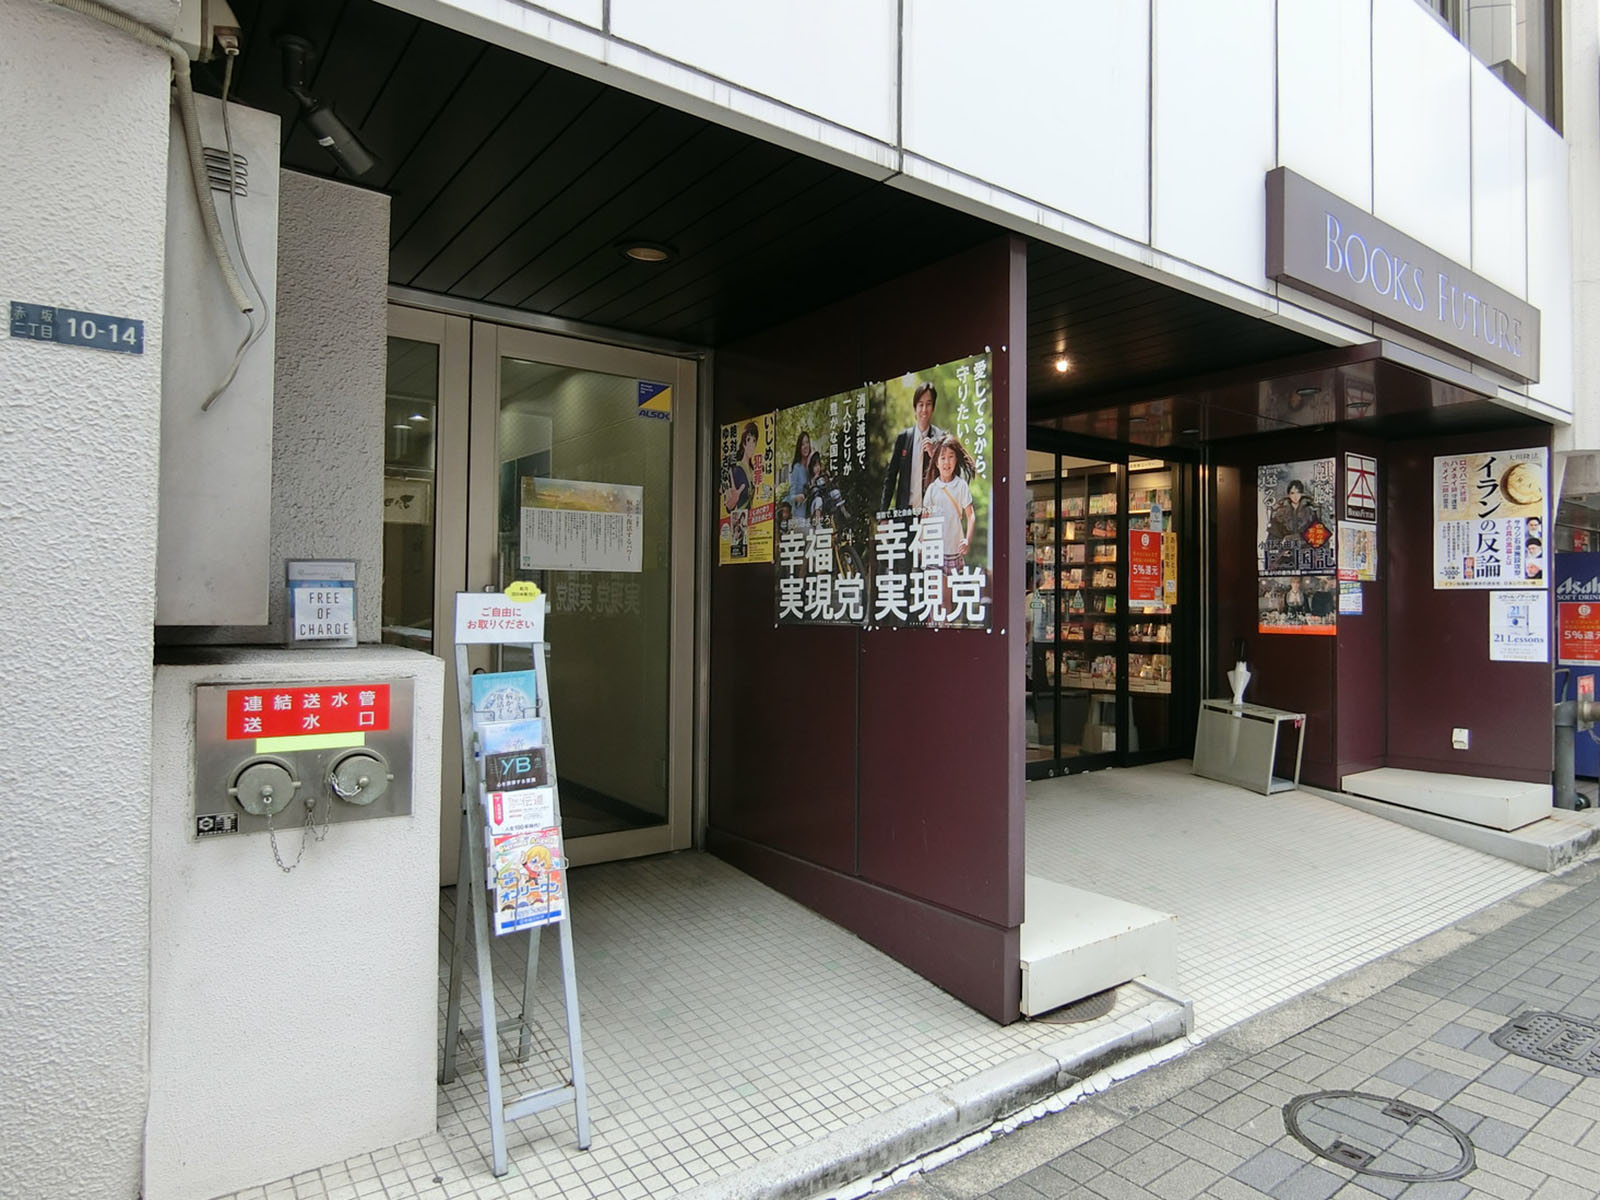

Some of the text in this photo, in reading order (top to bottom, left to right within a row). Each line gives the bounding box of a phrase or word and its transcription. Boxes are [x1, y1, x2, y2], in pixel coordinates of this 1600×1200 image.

[1325, 212, 1523, 358] BOOKS FUTURE
[14, 306, 53, 323] 赤坂
[14, 322, 53, 339] 二丁目
[67, 317, 137, 346] 10-14
[638, 409, 671, 421] ALSOK
[956, 365, 970, 446] 守りたい。
[973, 360, 987, 480] 愛してるから、
[764, 416, 774, 475] いじめは
[829, 402, 839, 478] 豊かな国に。
[843, 399, 852, 477] 一人ひとりが
[856, 392, 866, 470] 消費減税で、
[1476, 456, 1501, 579] イランの反論
[779, 527, 834, 574] 幸福
[875, 515, 946, 569] 幸福
[308, 592, 340, 605] FREE
[779, 570, 865, 621] 実現党
[874, 565, 987, 622] 実現党
[317, 608, 332, 620] OF
[466, 619, 535, 630] お取りください
[481, 606, 522, 617] ご自由に
[299, 622, 350, 636] CHARGE
[1494, 633, 1545, 644] 21 Lessons
[243, 690, 376, 713] 連結送水管
[243, 711, 376, 734] 送水口
[501, 756, 532, 776] YB
